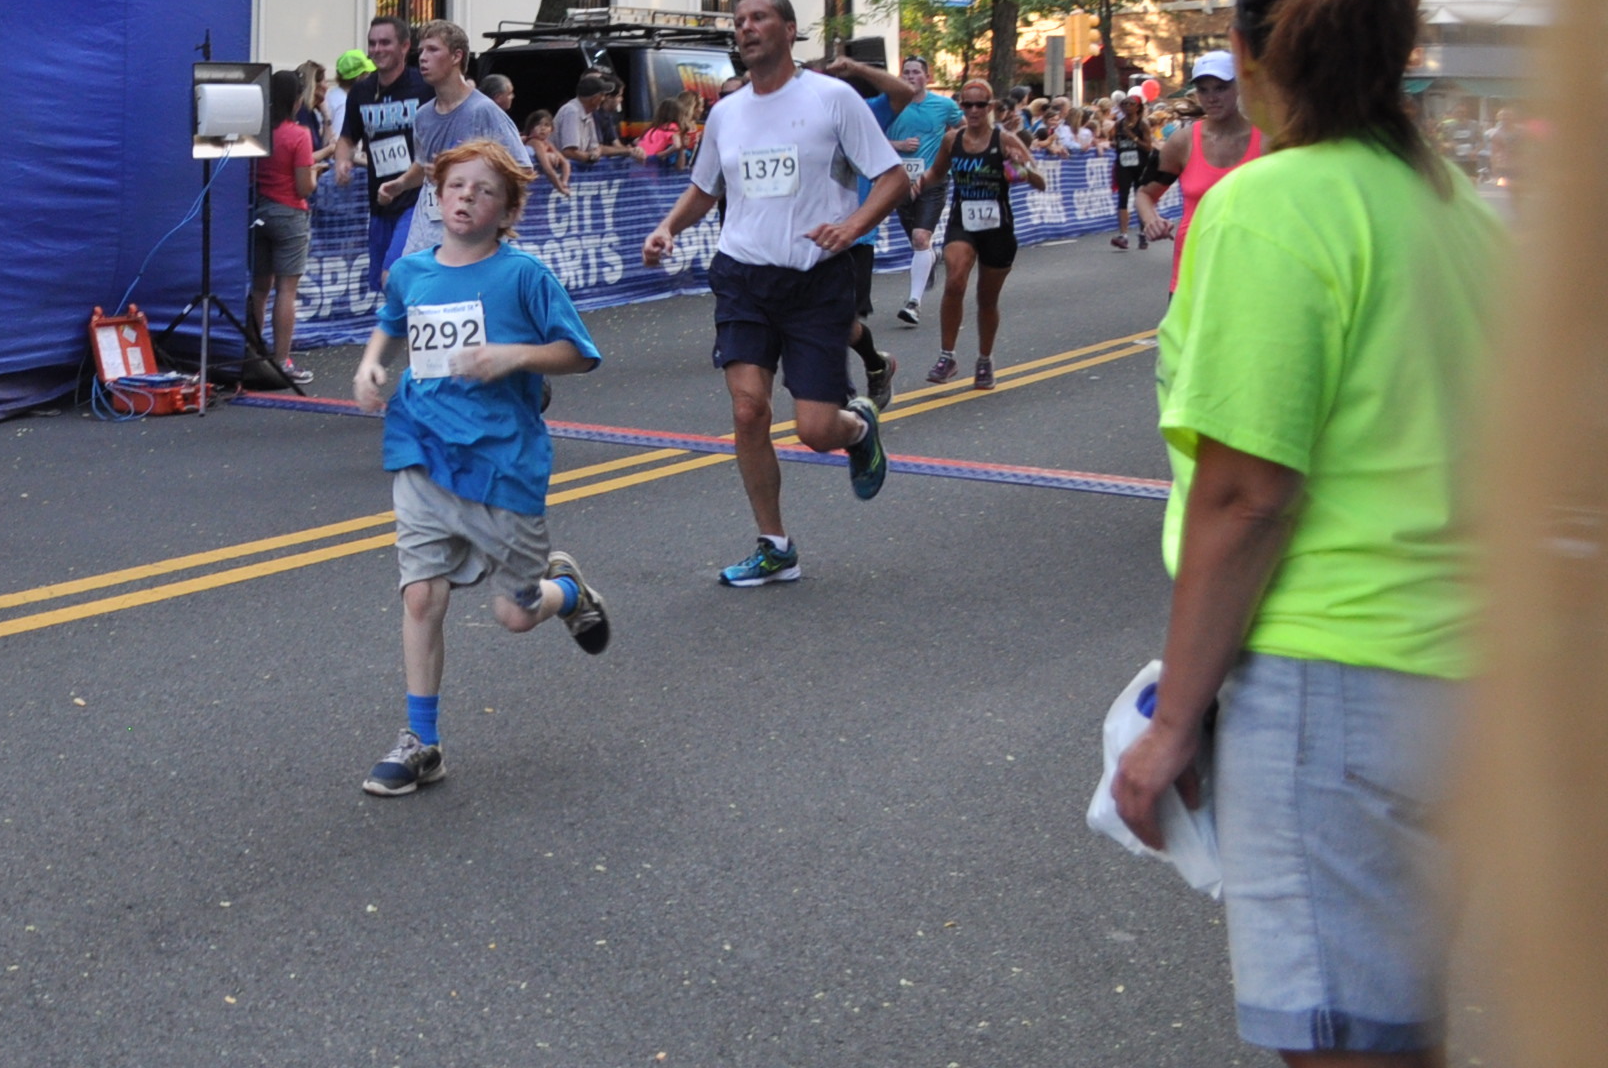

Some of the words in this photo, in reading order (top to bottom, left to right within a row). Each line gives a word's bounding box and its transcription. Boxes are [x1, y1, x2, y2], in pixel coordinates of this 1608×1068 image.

[373, 144, 407, 165] 1140
[903, 163, 920, 173] 07
[951, 156, 984, 172] RUN
[742, 157, 796, 181] 1379
[548, 179, 623, 238] CITY
[968, 208, 993, 221] 317
[504, 232, 624, 289] ORTS
[662, 221, 721, 277] SPO
[295, 253, 386, 322] SPO
[410, 319, 481, 352] 2292
